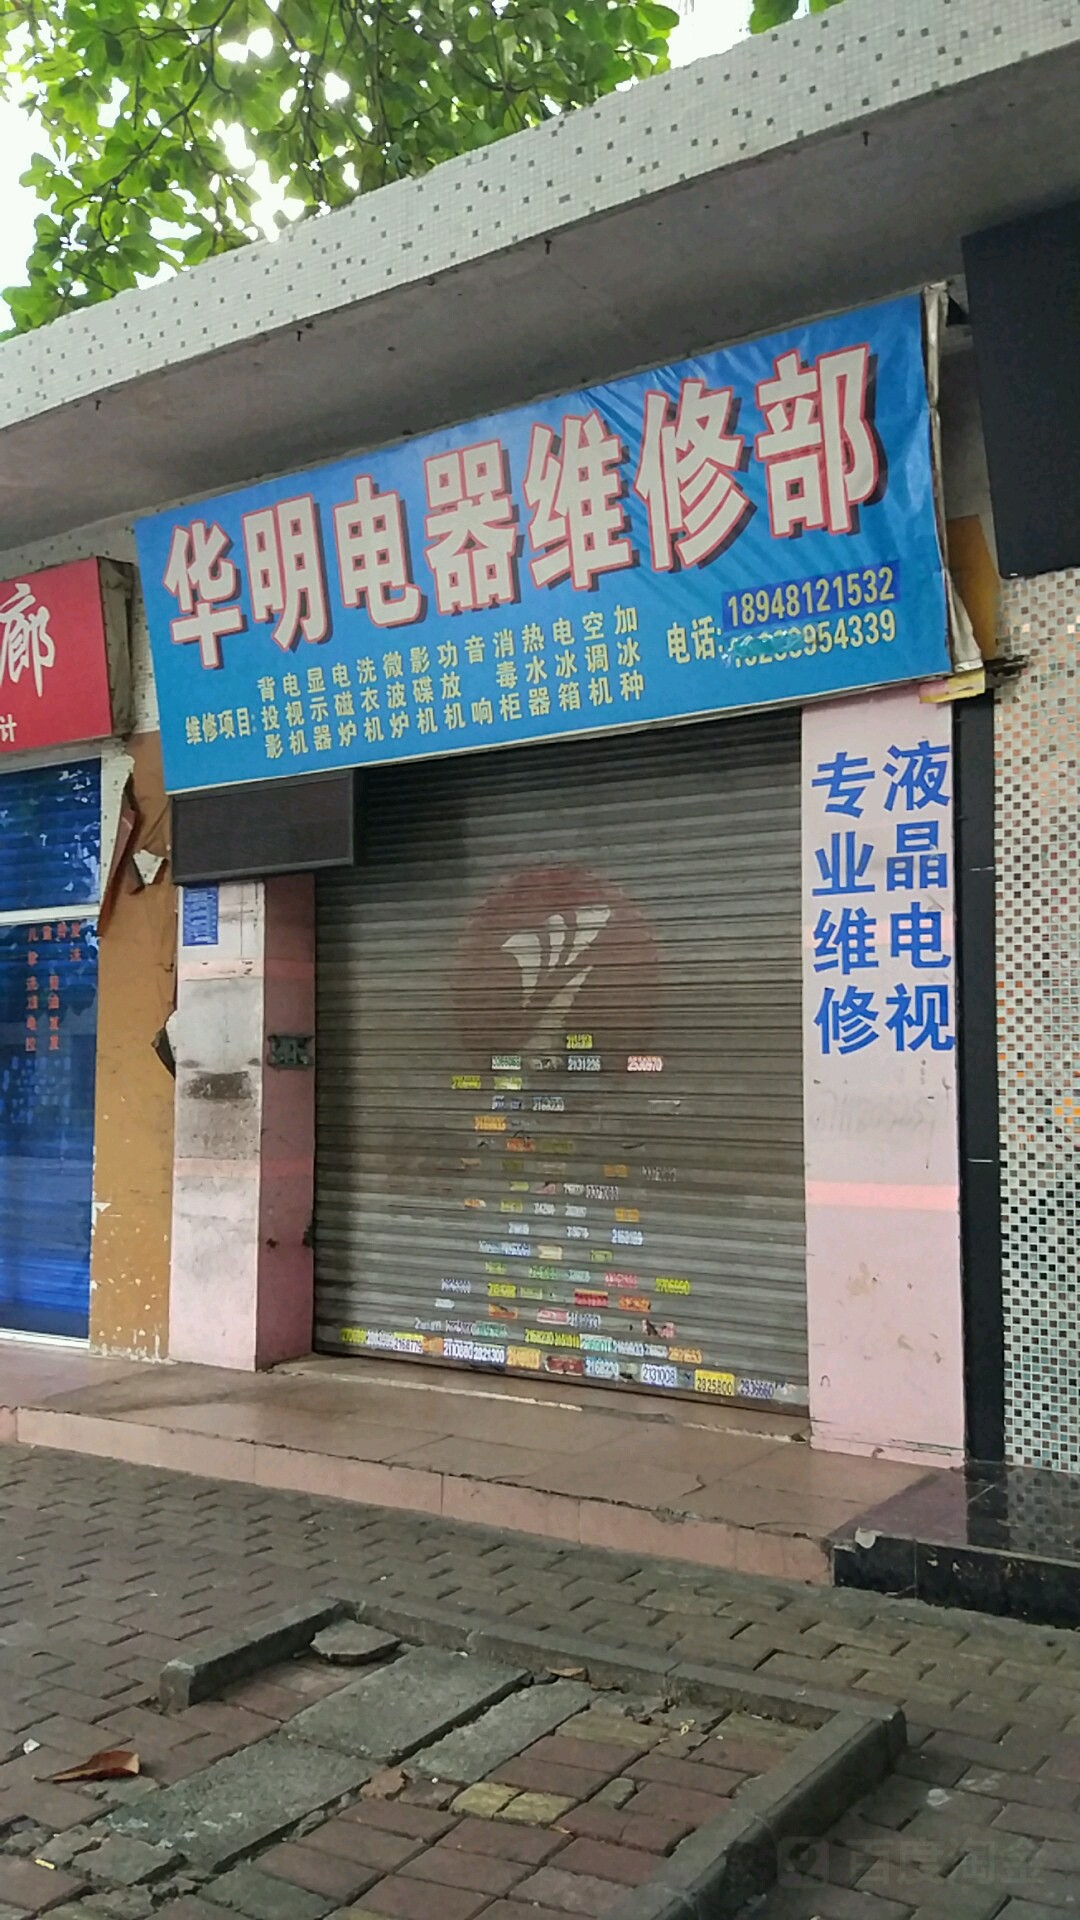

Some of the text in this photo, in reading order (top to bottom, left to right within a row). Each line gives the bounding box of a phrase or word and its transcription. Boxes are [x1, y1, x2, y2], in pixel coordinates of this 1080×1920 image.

[163, 342, 881, 669] 华明电器维修部
[0, 583, 56, 697] 廊
[667, 615, 723, 663] 电话:
[728, 566, 895, 627] 18948121532
[383, 651, 410, 739] 微波炉
[410, 645, 438, 735] 影碟机
[437, 640, 466, 730] 功放机
[464, 635, 494, 725] 音响
[493, 628, 523, 722] 消毒柜
[522, 622, 551, 717] 热水器
[552, 617, 581, 711] 电冰箱
[582, 611, 613, 707] 空调机
[614, 604, 644, 701] 加冰种
[257, 676, 283, 760] 背投影
[282, 672, 308, 755] 电视机
[306, 666, 332, 752] 显示器
[332, 662, 357, 747] 电磁炉
[357, 656, 384, 743] 洗衣机
[812, 751, 879, 1056] 专业维修
[882, 740, 955, 1052] 液晶电视
